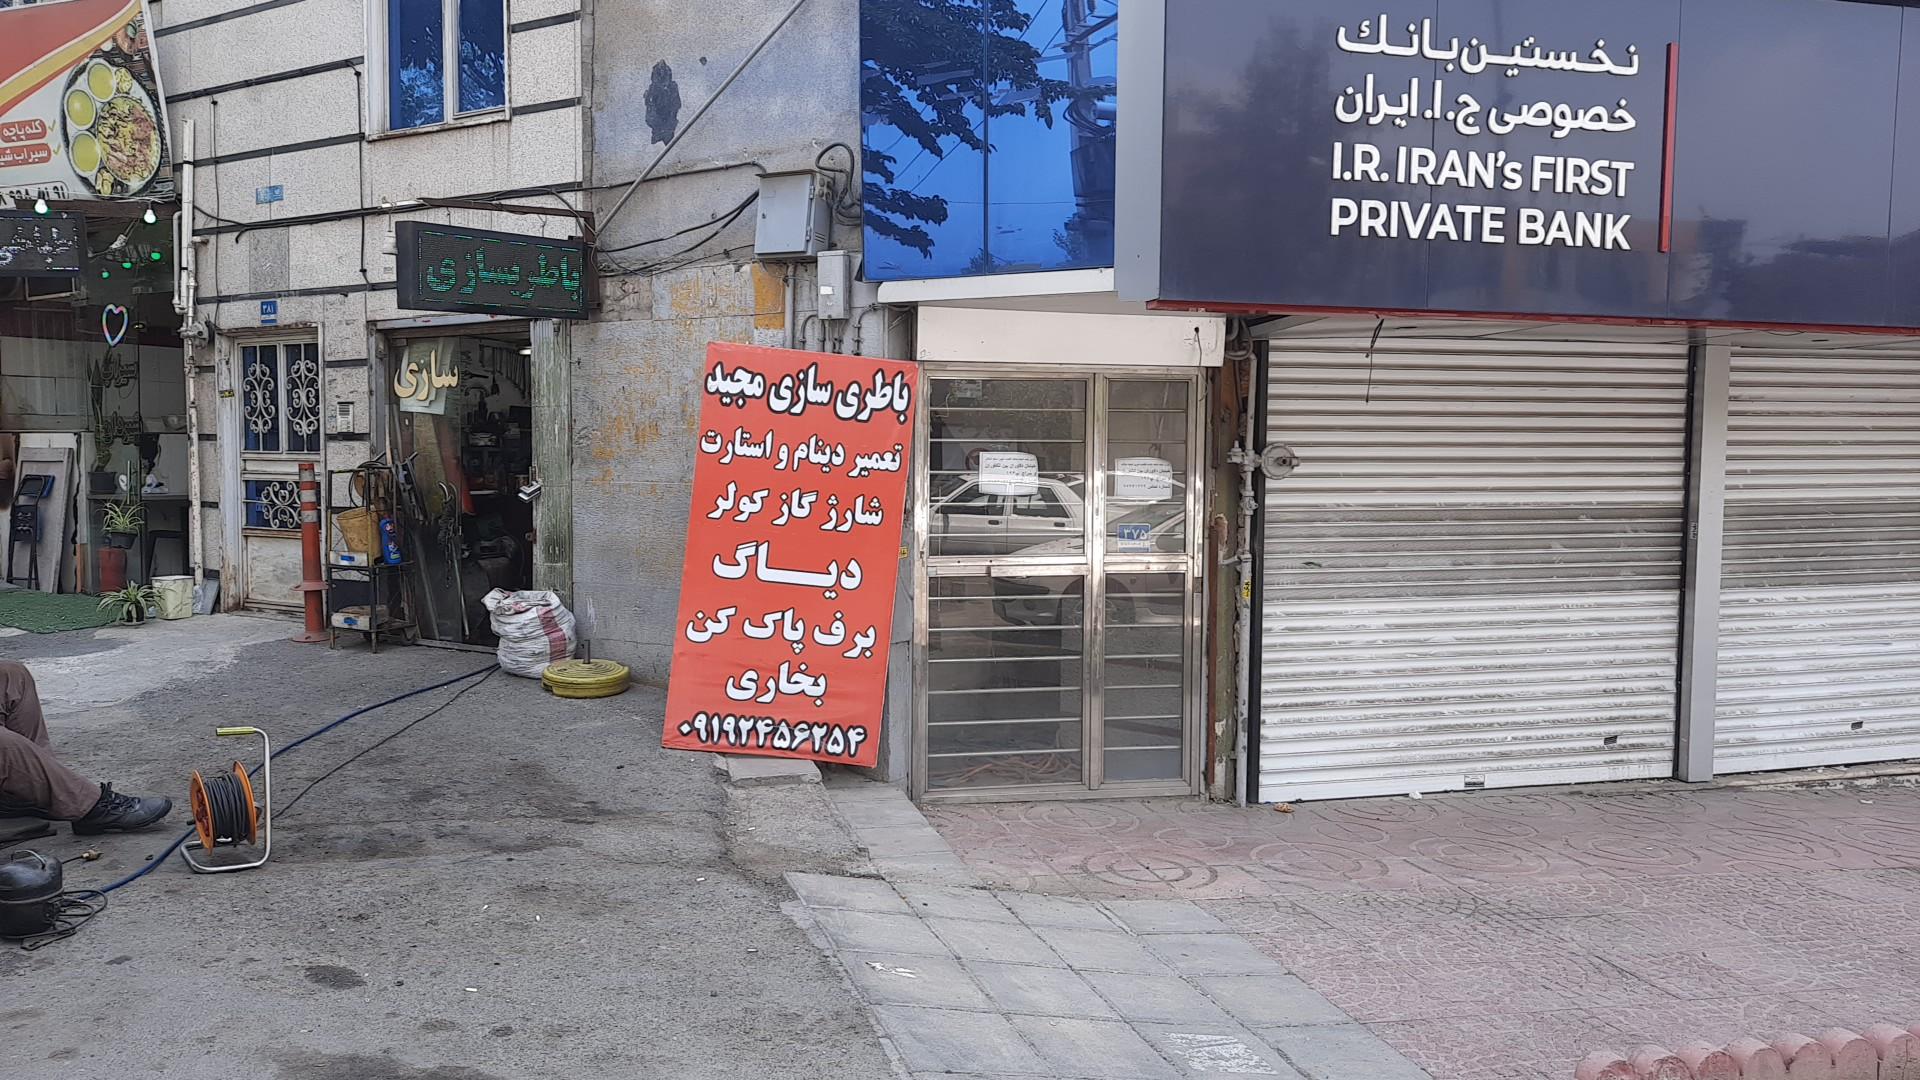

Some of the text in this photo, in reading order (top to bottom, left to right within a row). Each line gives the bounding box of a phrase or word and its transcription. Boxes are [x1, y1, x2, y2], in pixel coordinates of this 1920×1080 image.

[1459, 35, 1641, 79] نخستین
[1487, 96, 1638, 140] خصوصی
[1331, 141, 1635, 198] I.R. IRAN's FIRST
[1330, 197, 1632, 251] PRIVATE BANK
[393, 348, 461, 401] سازی
[704, 361, 912, 423] باطری سازی مجید
[699, 426, 903, 478] تعمیر دینام و استارت
[706, 480, 884, 532] شارژ گاز کولر
[1123, 528, 1148, 540] ۳۷۵
[712, 541, 863, 600] دیاگ
[685, 605, 877, 659] برف پاک کن
[725, 660, 827, 707] بخاری
